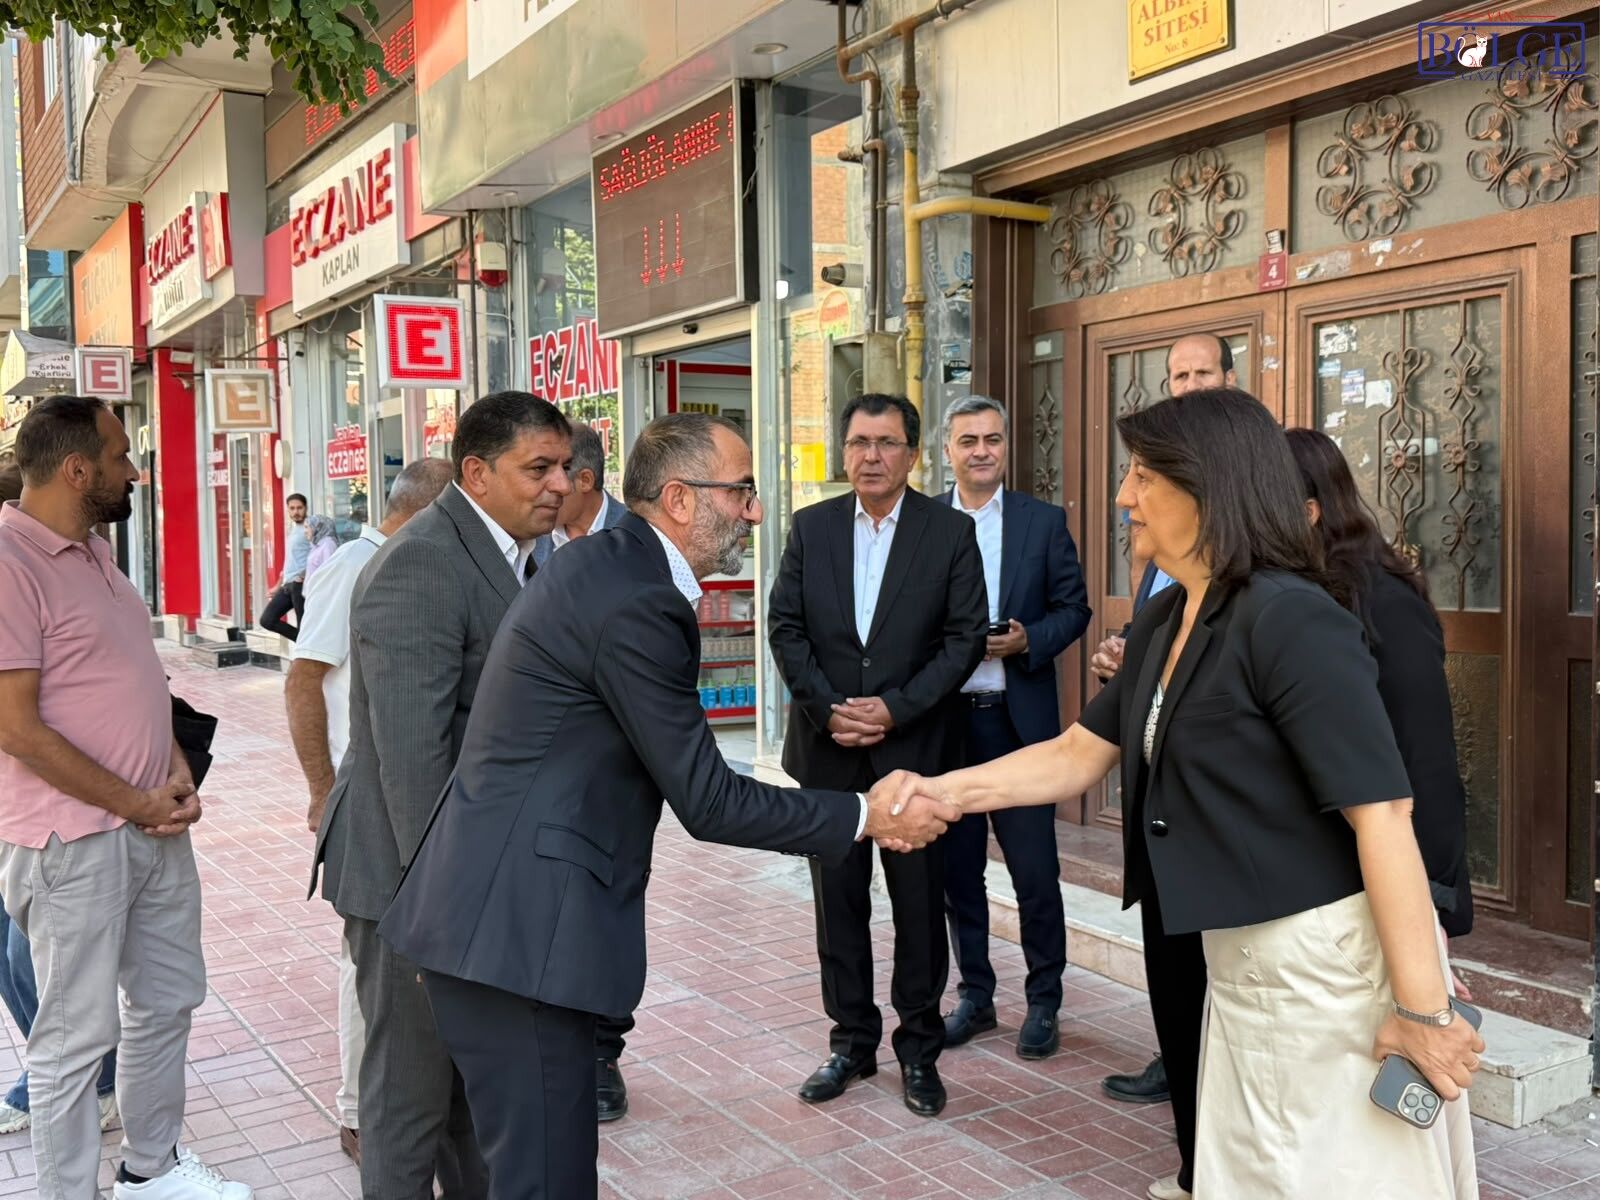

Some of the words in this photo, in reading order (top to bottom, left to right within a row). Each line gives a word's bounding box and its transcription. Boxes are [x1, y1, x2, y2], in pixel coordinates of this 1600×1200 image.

[1143, 1, 1209, 47] SİTESİ
[289, 147, 393, 268] ECZANE
[146, 206, 195, 287] ECZANE
[322, 243, 360, 287] KAPLAN
[405, 319, 444, 365] E
